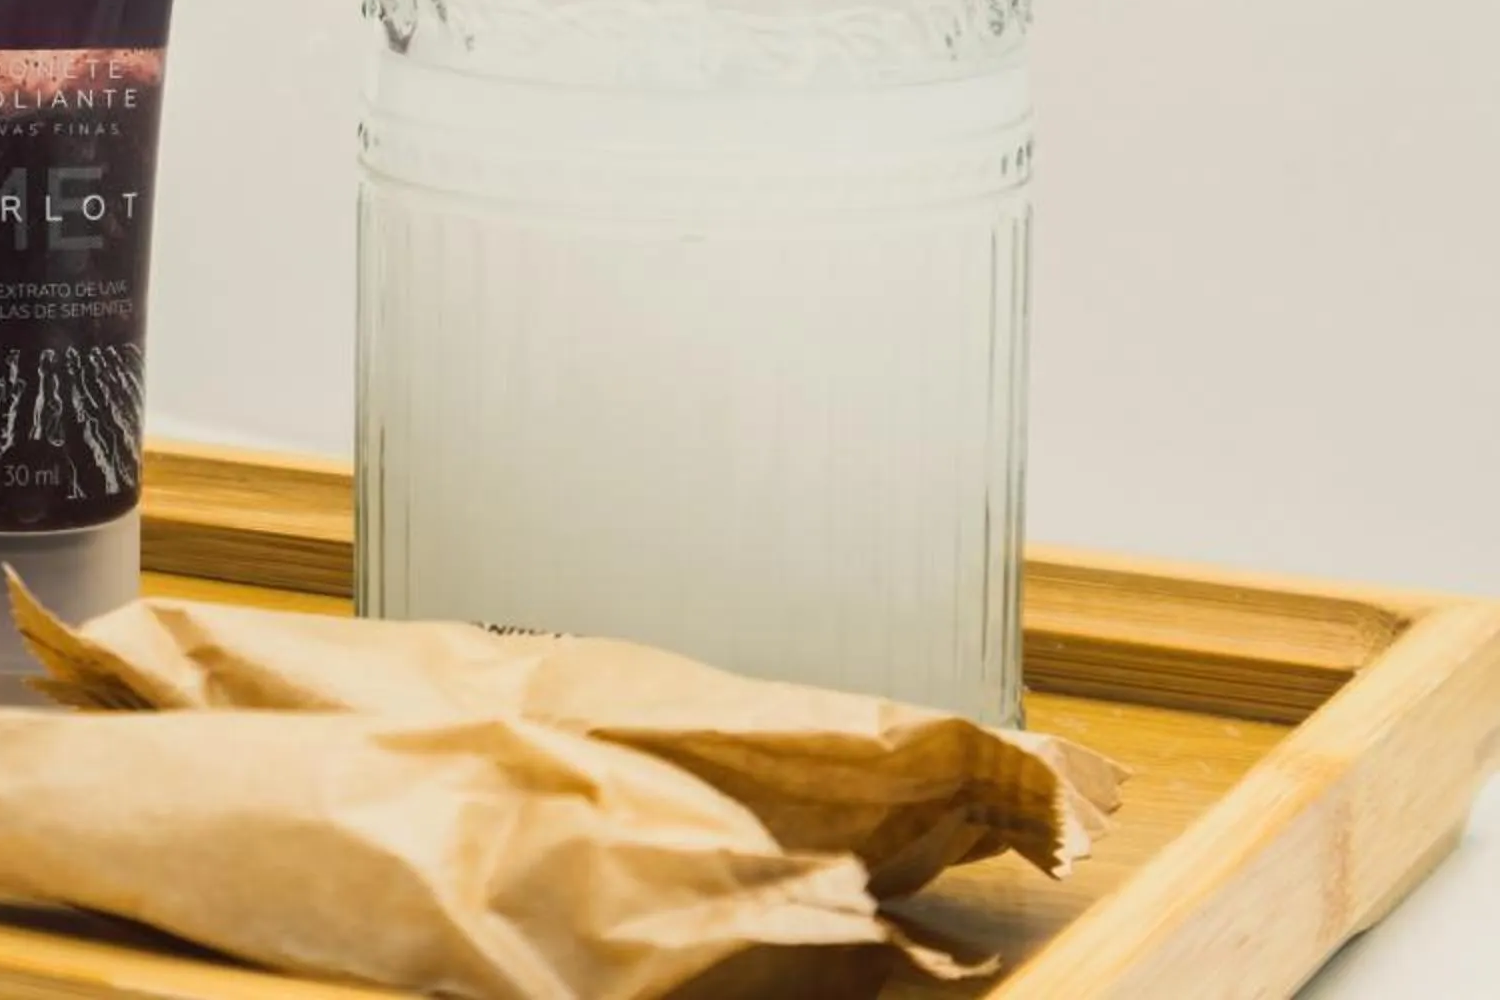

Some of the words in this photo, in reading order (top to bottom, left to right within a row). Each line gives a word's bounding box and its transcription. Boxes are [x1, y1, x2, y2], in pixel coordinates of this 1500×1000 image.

[52, 121, 122, 138] FINAS
[74, 280, 98, 298] DE
[33, 302, 57, 319] DE
[2, 463, 30, 487] 30
[34, 463, 61, 487] ml
